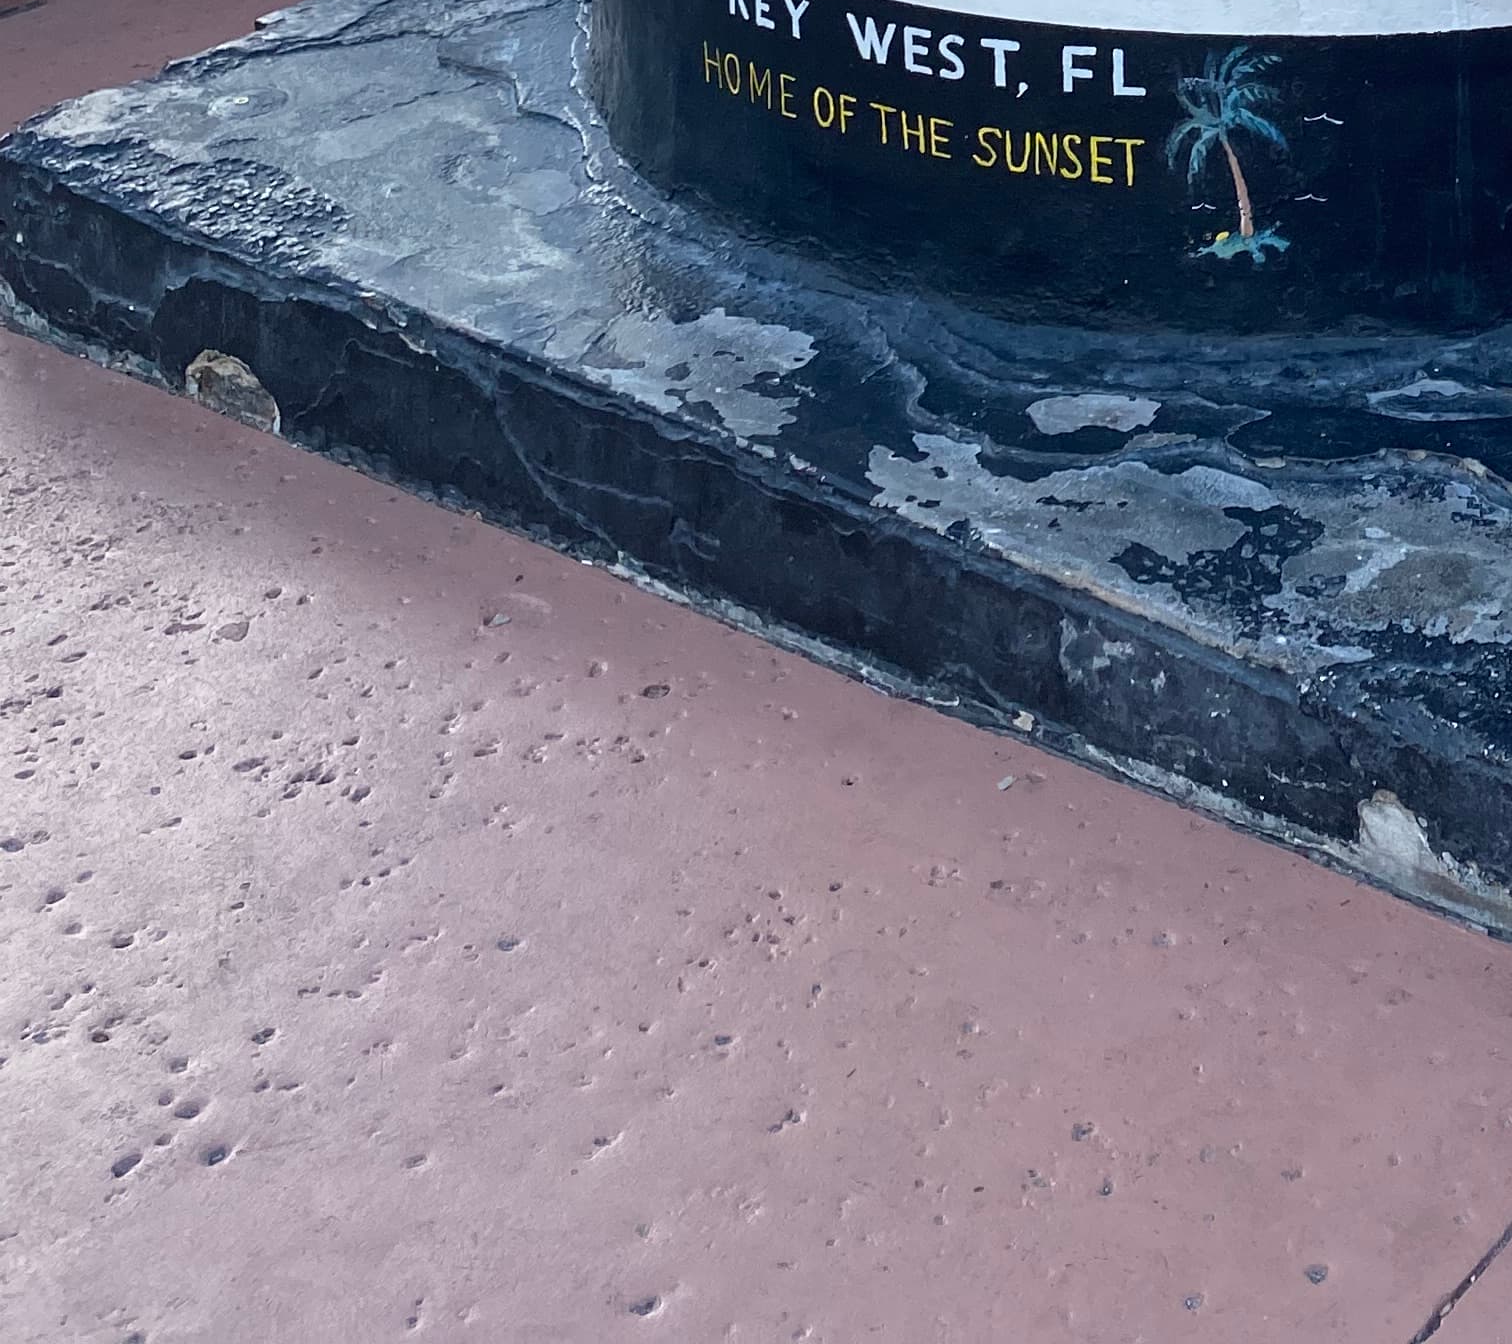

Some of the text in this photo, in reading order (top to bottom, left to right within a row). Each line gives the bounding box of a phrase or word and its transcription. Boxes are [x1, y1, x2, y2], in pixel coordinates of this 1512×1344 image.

[846, 12, 1029, 99] WEST,
[1062, 45, 1147, 97] FL
[703, 41, 1146, 188] HOME OF THE SUNSET
